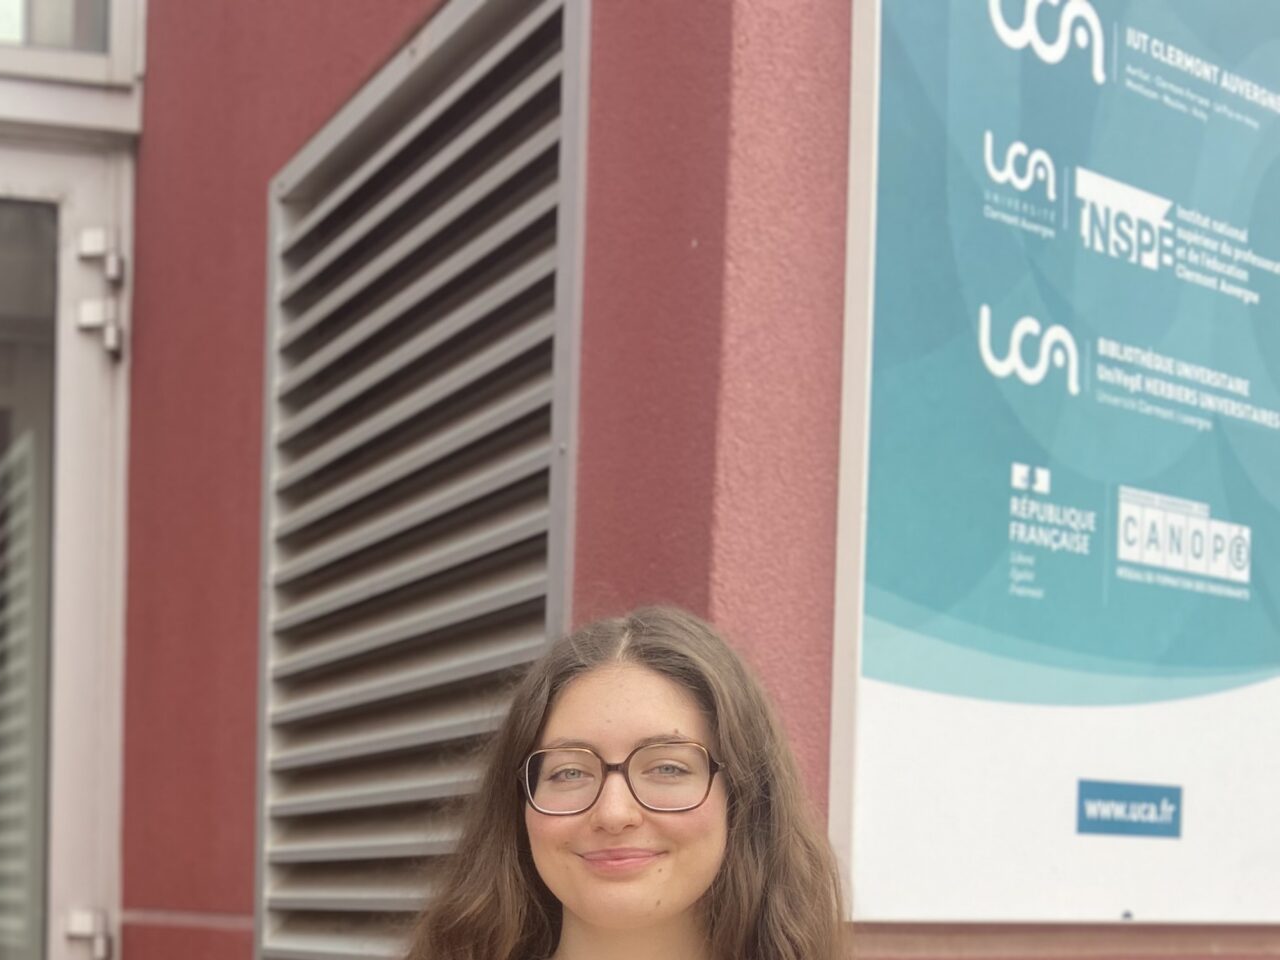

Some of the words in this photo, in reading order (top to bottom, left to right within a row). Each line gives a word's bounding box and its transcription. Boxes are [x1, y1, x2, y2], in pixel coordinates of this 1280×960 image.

[1125, 26, 1150, 54] IUT
[1150, 37, 1219, 86] CLERMONT
[1211, 219, 1249, 244] national
[1187, 248, 1199, 266] de
[1220, 240, 1233, 257] du
[1175, 262, 1218, 291] Clermont
[1219, 277, 1260, 305] Auvergne
[1144, 376, 1198, 406] HERBIERS
[1175, 360, 1251, 398] UNIVERSITAIRE
[1010, 494, 1097, 533] RÉPUBLIQUE
[1009, 520, 1091, 556] FRANÇAISE
[1083, 797, 1176, 824] www.uca.fr
